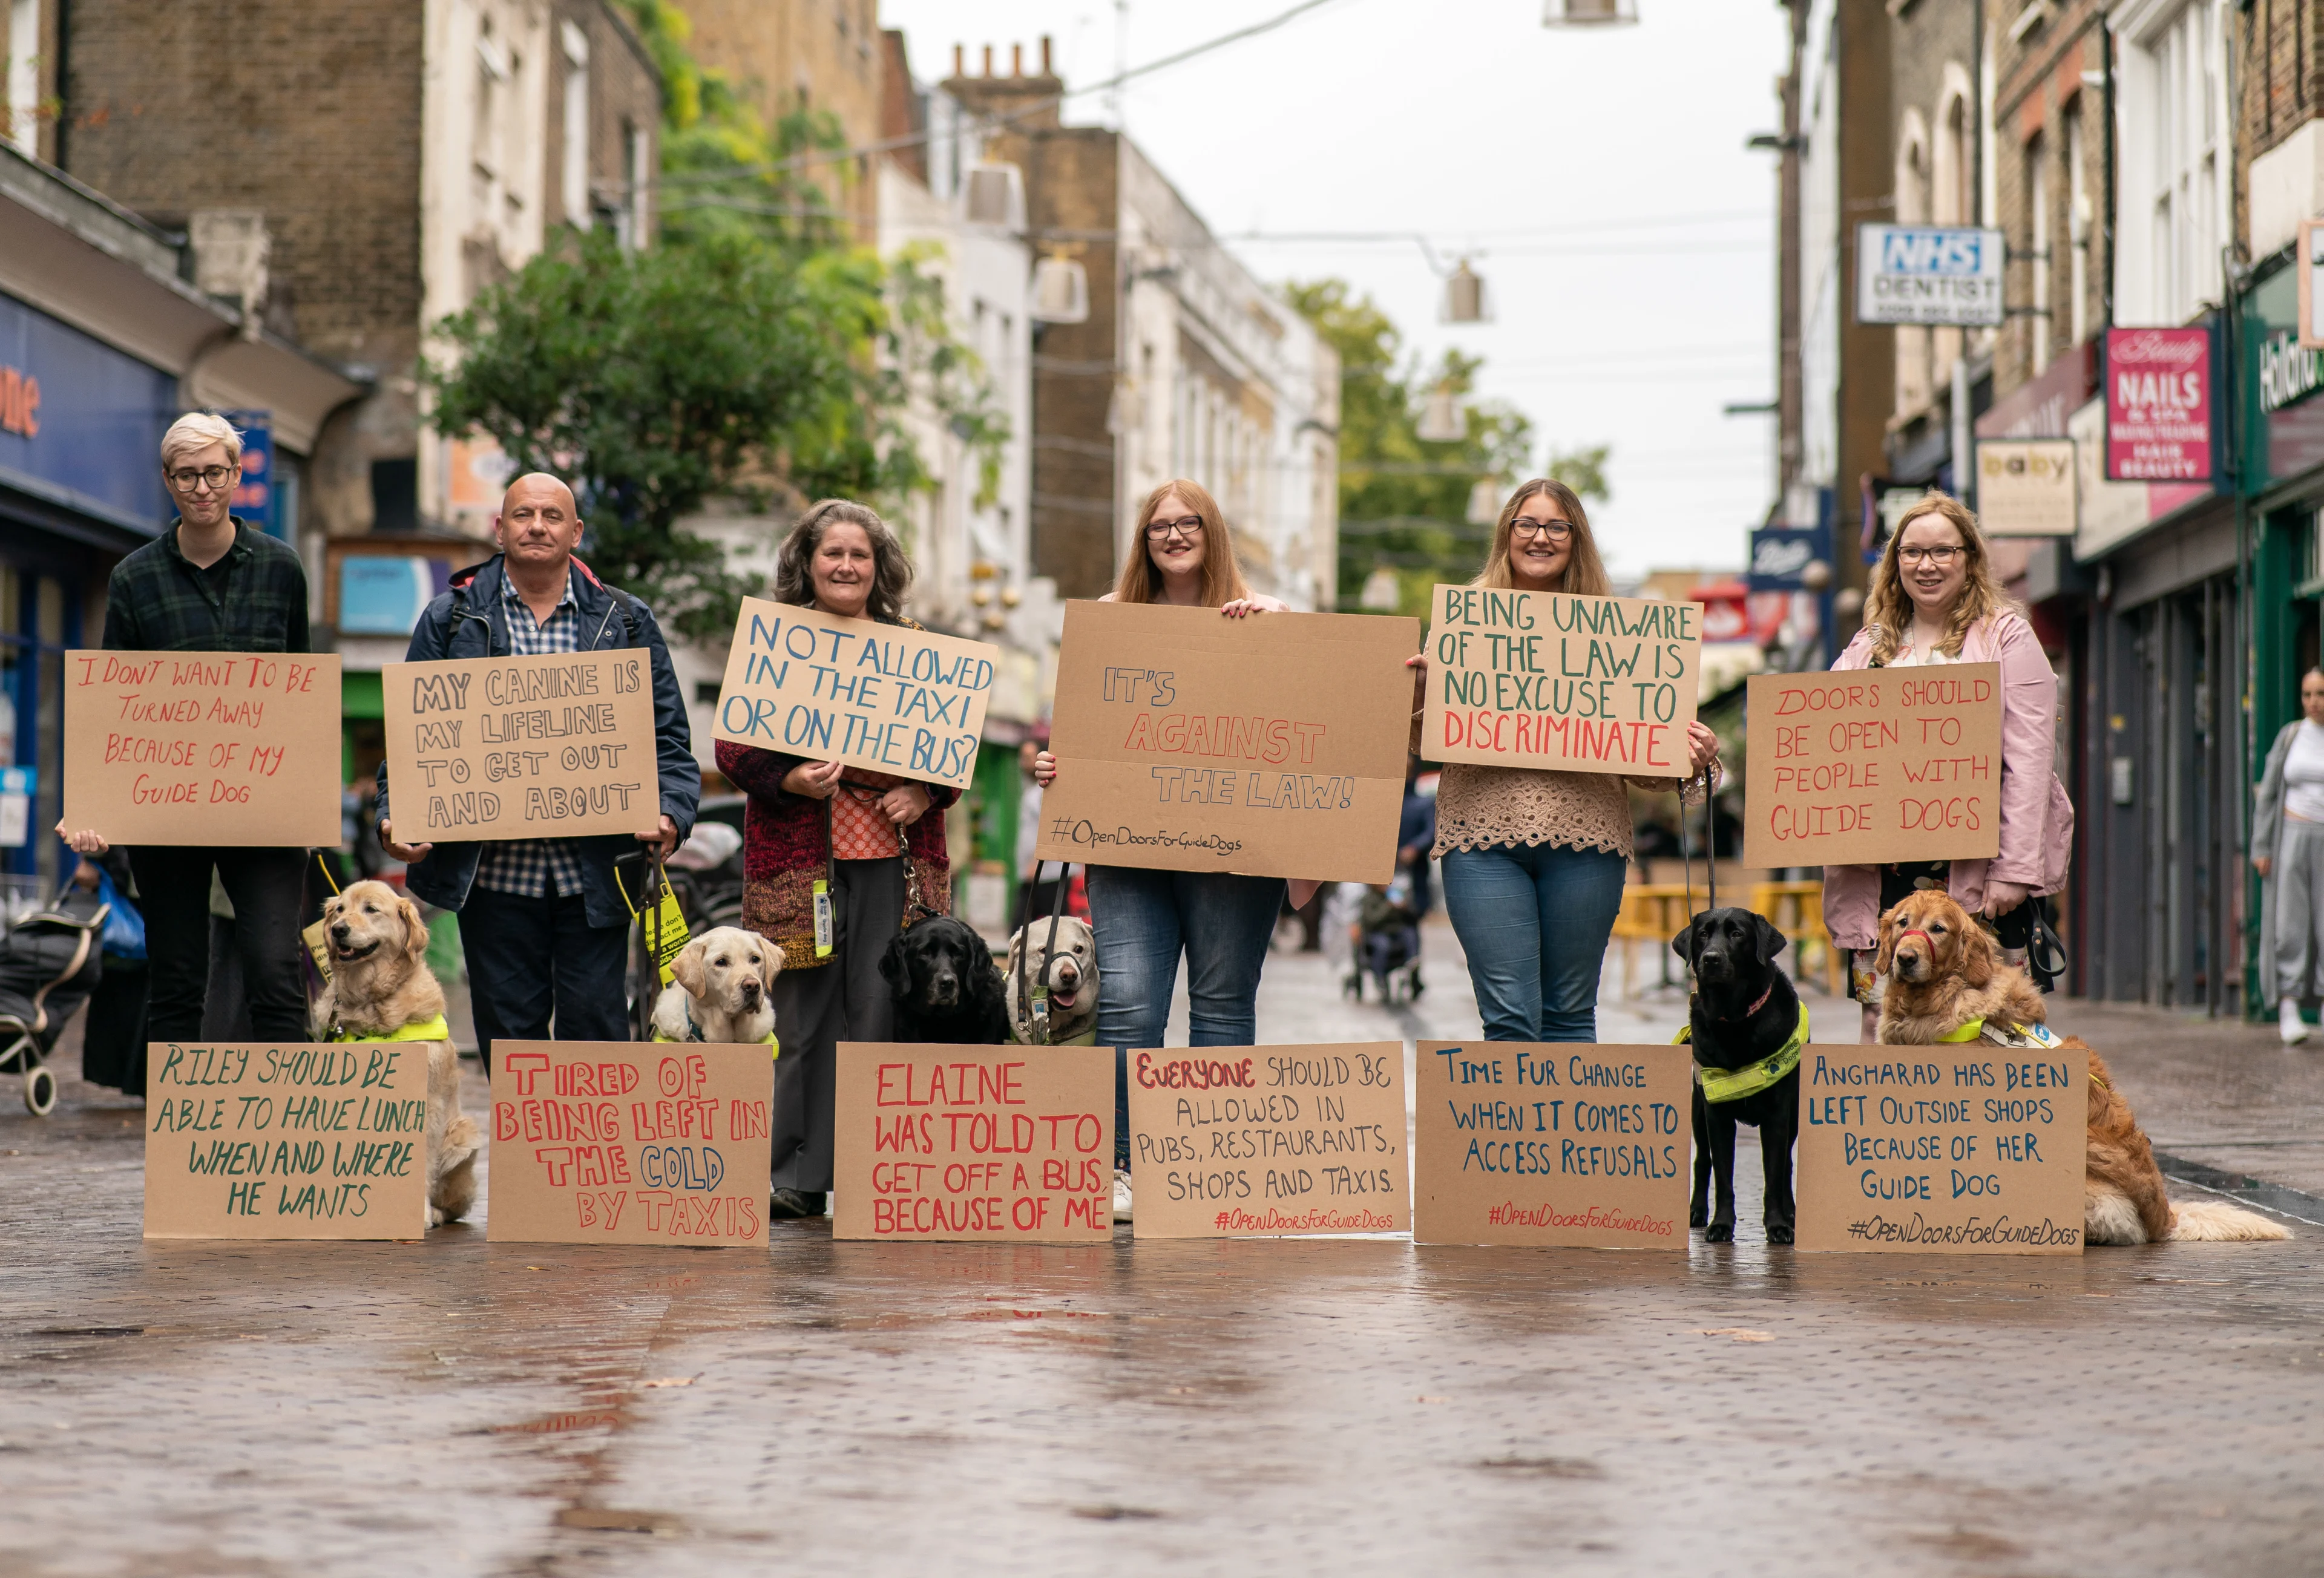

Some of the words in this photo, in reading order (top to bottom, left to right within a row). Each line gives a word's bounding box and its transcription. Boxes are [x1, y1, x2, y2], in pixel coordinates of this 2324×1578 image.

[1885, 234, 1979, 272] NHS
[1874, 277, 1995, 301] DENTIST
[2118, 370, 2202, 410] NAILS
[1983, 450, 2069, 485] baby
[2119, 459, 2198, 479] BEAUTY
[1445, 589, 1535, 630] BEING
[1552, 597, 1696, 641] UNAWARE
[749, 614, 856, 663] NOT
[857, 638, 993, 691] ALLOWED
[1438, 631, 1474, 668] OF
[1484, 633, 1545, 673] THE
[1561, 638, 1641, 679] LAW
[1655, 643, 1685, 679] IS
[78, 658, 99, 686] I
[172, 661, 238, 686] WANT
[246, 657, 277, 688] TO
[285, 663, 317, 693] BE
[413, 672, 471, 714] MY
[485, 664, 599, 706] CANINE
[614, 660, 640, 695] IS
[744, 652, 789, 690] IN
[809, 664, 882, 709] THE
[894, 681, 971, 729] TAXI
[1103, 667, 1175, 707] IT'S
[119, 694, 200, 722] TURNED
[206, 696, 264, 728] AWAY
[1445, 670, 1487, 708] NO
[1496, 673, 1617, 720] EXCUSE
[1632, 682, 1676, 724] TO
[1774, 684, 1880, 715] DOORS
[1902, 679, 1991, 707] SHOULD
[416, 719, 462, 753] MY
[481, 703, 617, 743] LIFELINE
[722, 695, 776, 740] OR
[784, 704, 835, 750] ON
[841, 713, 909, 766] THE
[909, 727, 978, 784] BUS?
[1124, 713, 1326, 764] AGAINST
[1444, 710, 1670, 767] DISCRIMINATE
[1774, 725, 1811, 759] BE
[1829, 718, 1899, 753] OPEN
[1916, 717, 1961, 745] TO
[104, 733, 198, 767] BECAUSE
[209, 743, 241, 769] OF
[249, 745, 285, 776] MY
[417, 758, 471, 787] TO
[484, 751, 549, 782] GET
[561, 744, 628, 771] OUT
[1774, 762, 1880, 794] PEOPLE
[1902, 755, 1988, 783] WITH
[133, 774, 199, 805] GUIDE
[209, 779, 251, 804] DOG
[428, 791, 501, 828] AND
[525, 782, 641, 820] ABOUT
[1152, 767, 1236, 804] THE
[1246, 773, 1354, 809] LAW!
[1770, 804, 1873, 841] GUIDE
[1899, 797, 1981, 831] DOGS
[665, 914, 683, 927] don't
[672, 926, 683, 934] me
[668, 934, 691, 950] workin
[159, 1044, 249, 1085] RILEY
[257, 1049, 357, 1085] SHOULD
[360, 1049, 401, 1089] BE
[1436, 1047, 1503, 1084] TIME
[1516, 1052, 1561, 1086] FUR
[1569, 1055, 1647, 1089] CHANGE
[1779, 1041, 1798, 1058] Guide
[1782, 1050, 1799, 1065] Dogs
[505, 1053, 640, 1097] TIRED
[658, 1054, 707, 1100] OF
[876, 1062, 1026, 1107] ELAINE
[1137, 1052, 1256, 1091] EVERYONE
[1266, 1056, 1350, 1088] SHOULD
[1354, 1053, 1391, 1088] BE
[1813, 1055, 1940, 1087] ANGHARAD
[1954, 1062, 1995, 1087] HAS
[2005, 1062, 2069, 1092] BEEN
[152, 1098, 226, 1133] ABLE
[237, 1096, 273, 1130] TO
[281, 1095, 356, 1133] HAVE
[356, 1095, 426, 1133] LUNCH
[495, 1099, 620, 1142] BEING
[631, 1098, 720, 1142] LEFT
[730, 1099, 768, 1141] IN
[1177, 1095, 1299, 1128] ALLOWED
[1316, 1095, 1345, 1123] IN
[1448, 1099, 1523, 1132] WHEN
[1532, 1099, 1565, 1132] IT
[1574, 1101, 1644, 1134] COMES
[1649, 1103, 1679, 1135] TO
[1809, 1095, 1868, 1126] LEFT
[1880, 1096, 1971, 1125] OUTSIDE
[1984, 1098, 2054, 1124] SHOPS
[875, 1113, 933, 1154] WAS
[941, 1112, 1034, 1154] TOLD
[1038, 1113, 1101, 1153] TO
[1136, 1133, 1203, 1164] PUBS,
[1210, 1124, 1396, 1159] RESTAURANTS,
[1844, 1132, 1942, 1165] BECAUSE
[1951, 1135, 1978, 1162] OF
[1997, 1132, 2044, 1163] HER
[189, 1140, 270, 1176] WHEN
[271, 1140, 325, 1176] AND
[332, 1140, 415, 1177] WHERE
[535, 1145, 632, 1187] THE
[640, 1145, 724, 1192] COLD
[872, 1162, 936, 1194] GET
[944, 1162, 1003, 1194] OFF
[1012, 1161, 1029, 1191] A
[1463, 1138, 1551, 1175] ACCESS
[1561, 1138, 1676, 1180] REFUSALS
[226, 1181, 266, 1216] HE
[278, 1182, 372, 1221] WANTS
[1167, 1169, 1252, 1201] SHOPS
[1265, 1168, 1313, 1199] AND
[1322, 1165, 1394, 1196] TAXIS.
[1860, 1169, 1931, 1200] GUIDE
[1951, 1169, 2001, 1199] DOG
[576, 1190, 627, 1231] BY
[635, 1190, 760, 1240] TAXIS
[873, 1196, 1005, 1234] BECAUSE
[1012, 1196, 1050, 1230] OF
[1064, 1196, 1107, 1230] ME
